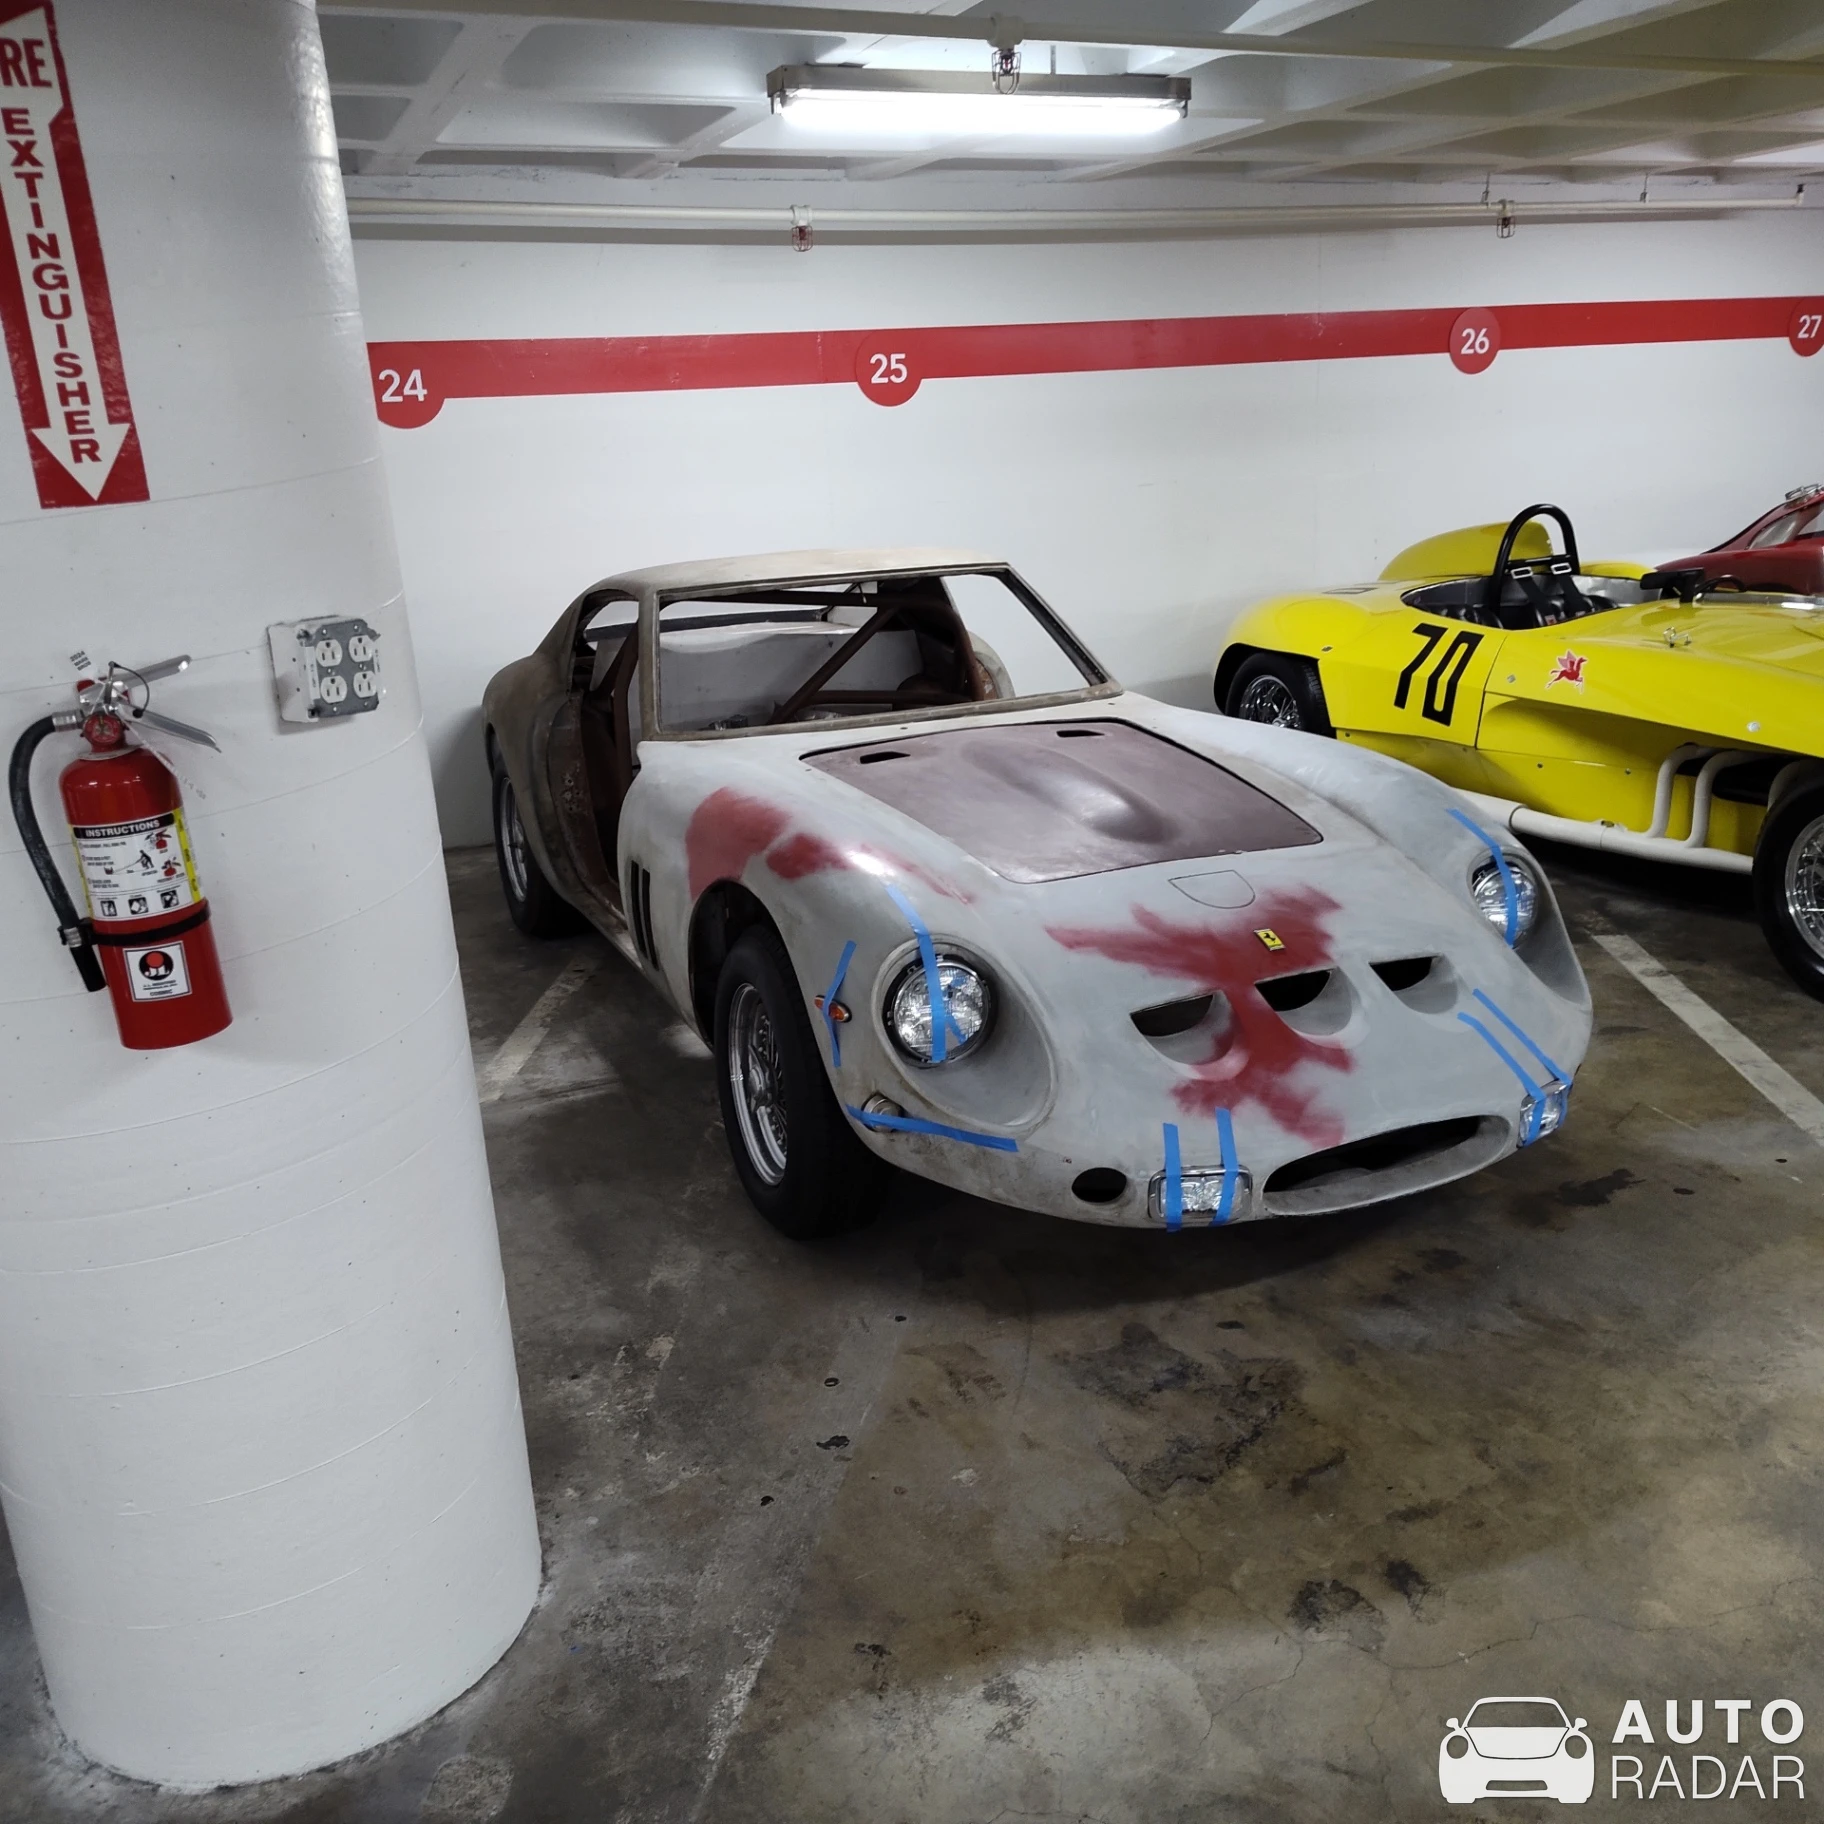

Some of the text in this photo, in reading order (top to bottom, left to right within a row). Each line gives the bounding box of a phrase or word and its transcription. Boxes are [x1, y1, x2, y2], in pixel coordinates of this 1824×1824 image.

[1, 108, 103, 464] EXTINGUISHER
[1460, 327, 1491, 355] 26
[1797, 314, 1823, 340] 27
[869, 353, 908, 385] 25
[378, 369, 428, 404] 24
[1393, 622, 1485, 728] 70
[85, 819, 160, 838] INSTRUCTIONS
